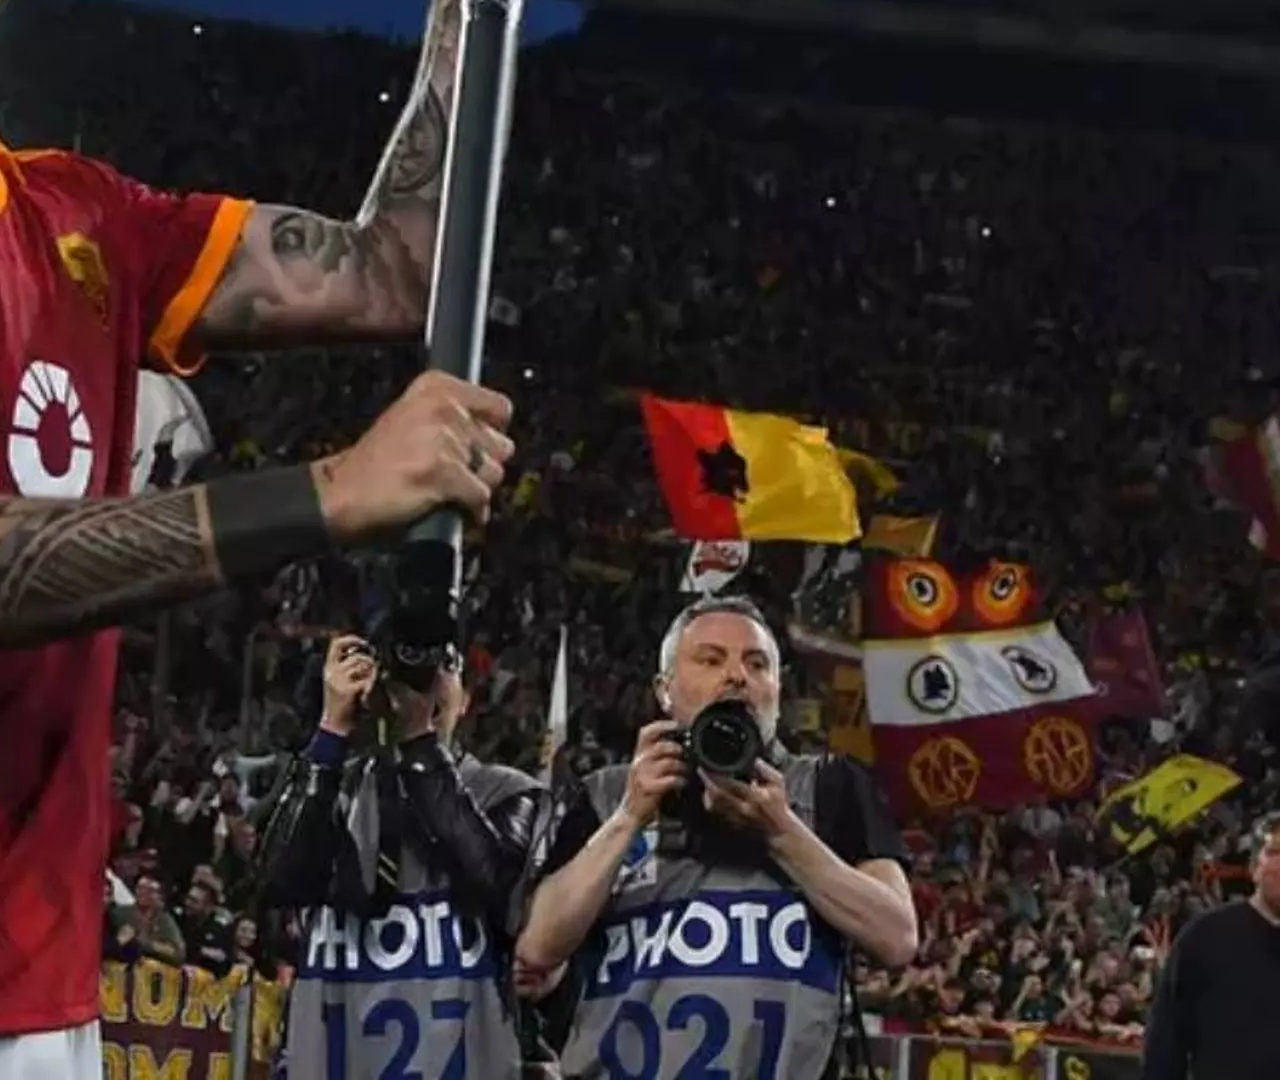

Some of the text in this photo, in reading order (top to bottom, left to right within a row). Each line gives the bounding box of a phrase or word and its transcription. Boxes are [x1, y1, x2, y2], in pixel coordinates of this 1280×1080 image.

[304, 902, 487, 970] HOTO
[597, 901, 812, 984] PHOTO
[322, 997, 472, 1080] 127
[598, 993, 787, 1080] 021
